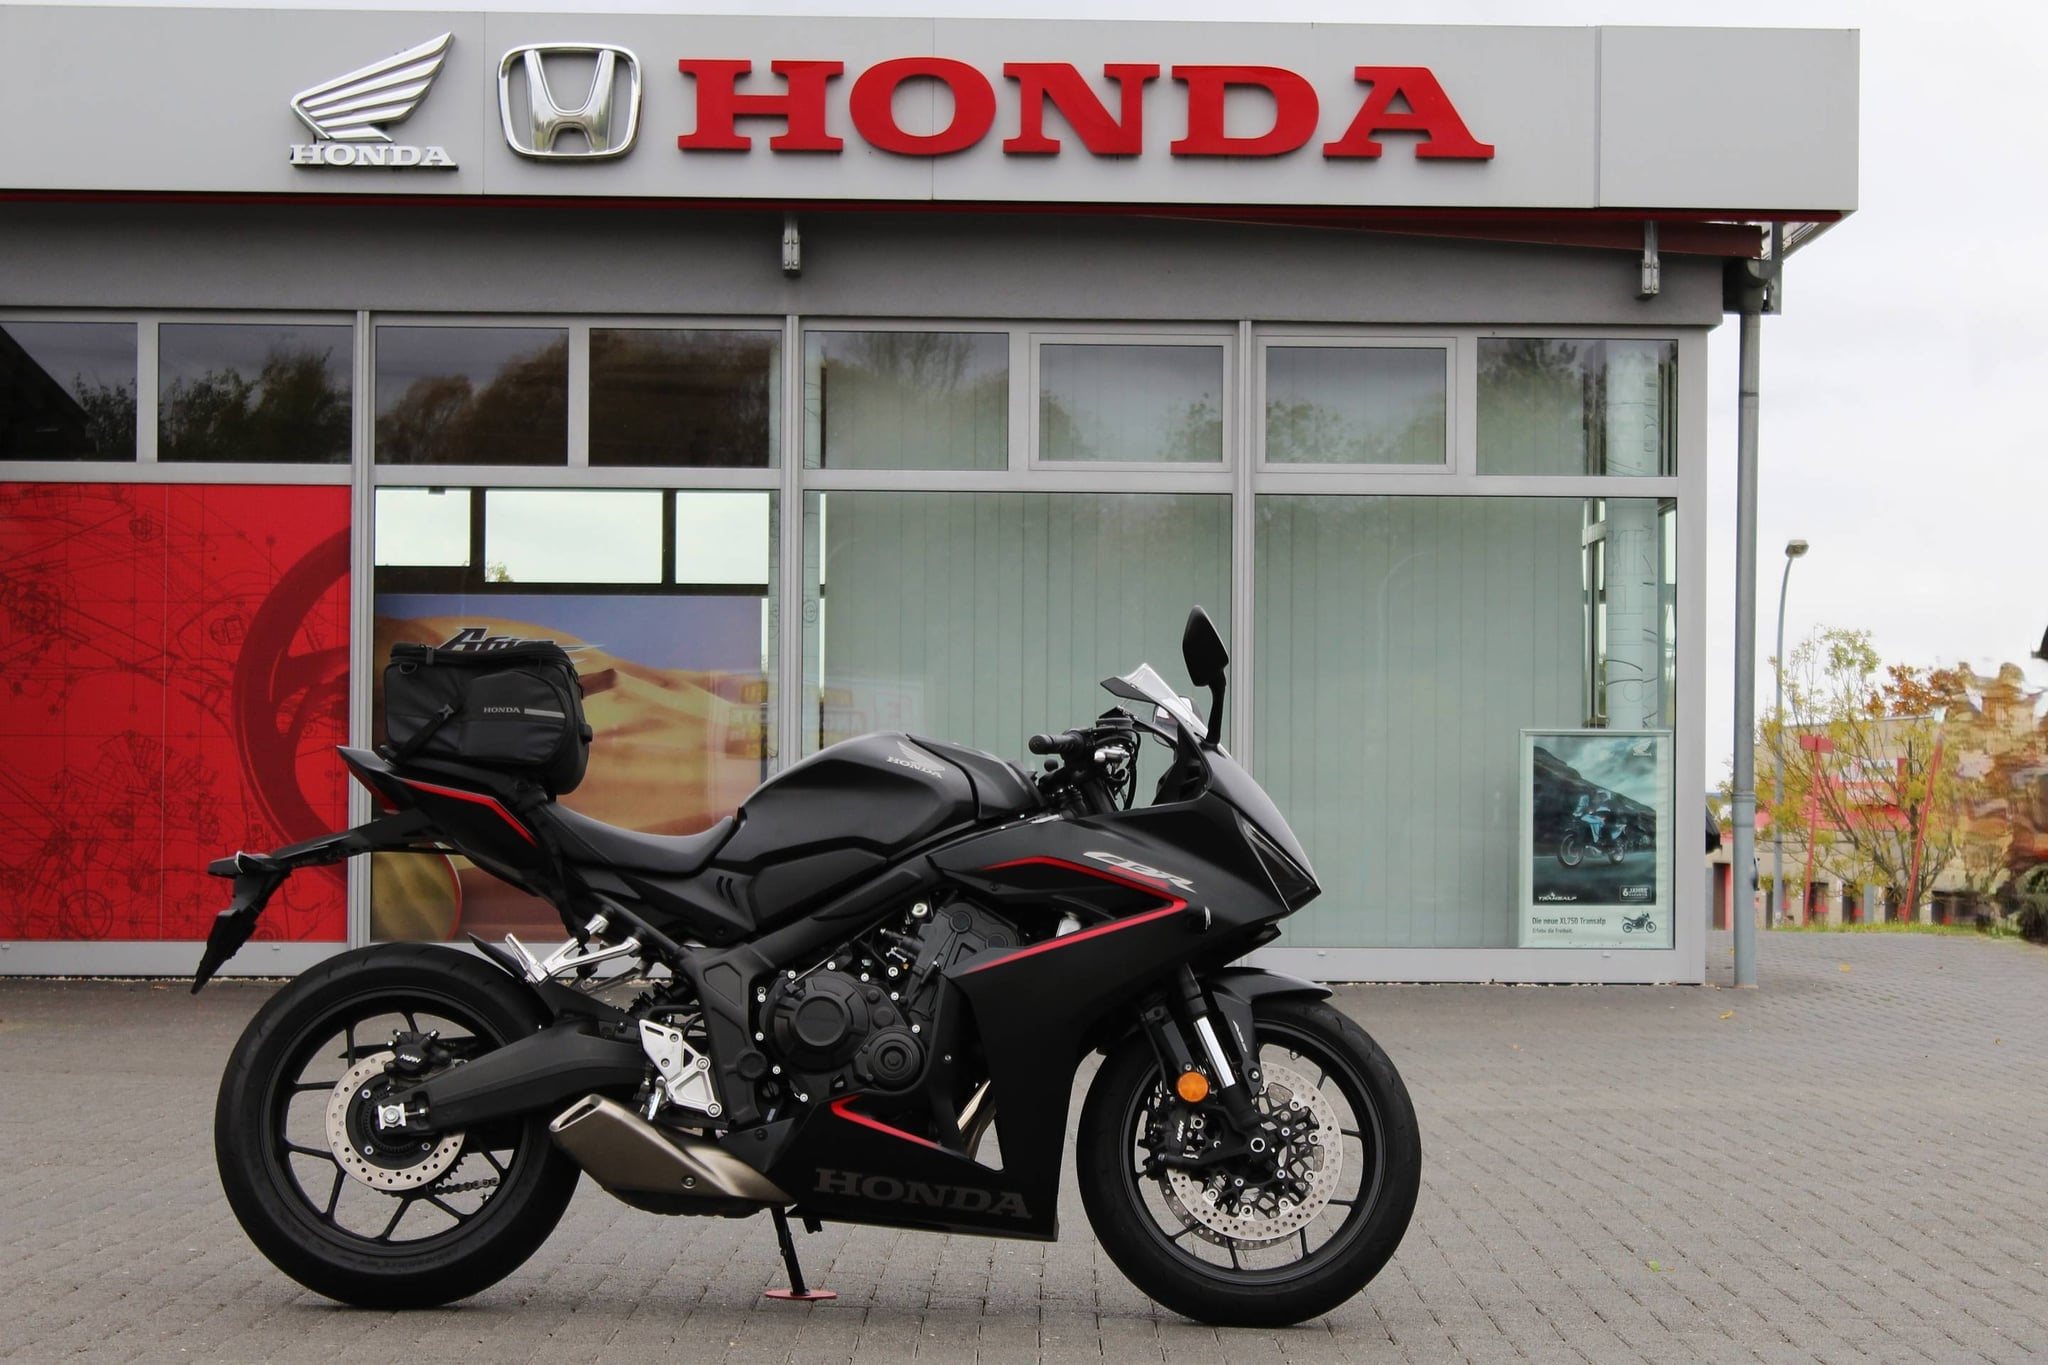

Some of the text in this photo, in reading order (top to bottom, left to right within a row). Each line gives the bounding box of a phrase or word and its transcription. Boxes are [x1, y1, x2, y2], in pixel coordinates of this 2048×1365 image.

[677, 57, 1495, 159] HONDA
[290, 144, 458, 169] HONDA
[483, 706, 521, 714] HONDA
[886, 755, 942, 779] HONDA
[1083, 851, 1197, 894] CBR
[1622, 887, 1629, 897] 6
[1532, 917, 1542, 925] Die
[1560, 917, 1579, 925] XL750
[1580, 917, 1607, 926] Transalp
[813, 1168, 1033, 1220] HONDA
